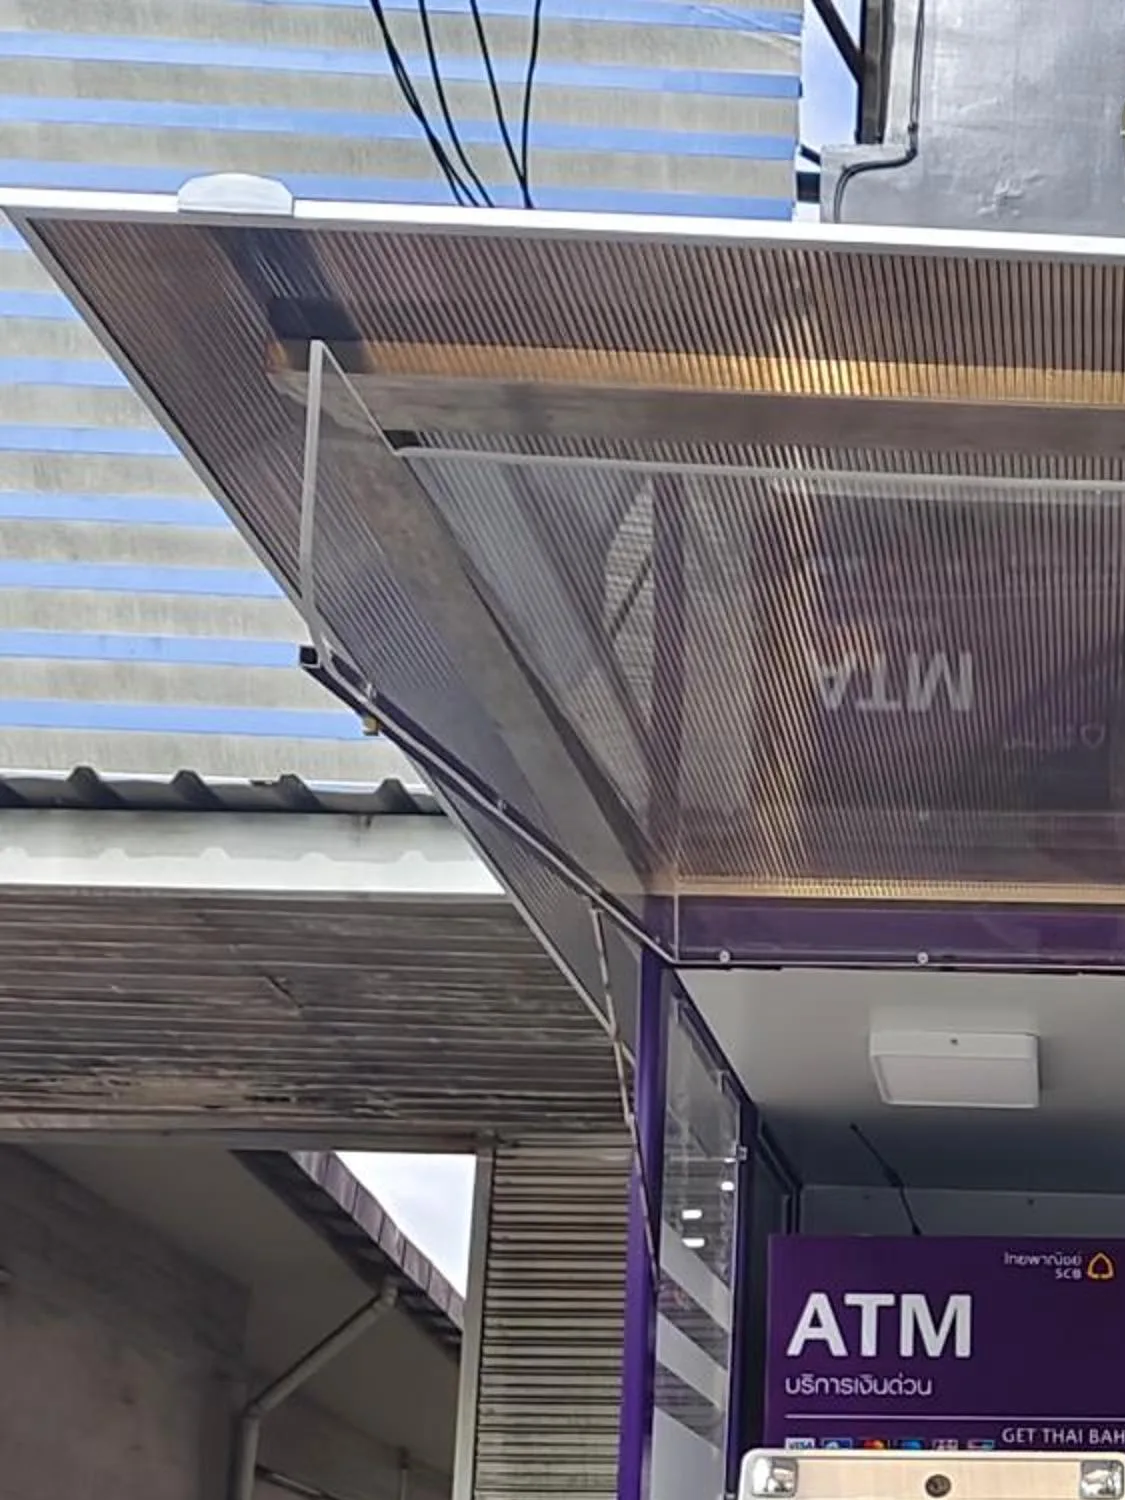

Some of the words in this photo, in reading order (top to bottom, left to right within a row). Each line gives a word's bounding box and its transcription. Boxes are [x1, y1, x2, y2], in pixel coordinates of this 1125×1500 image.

[1055, 1267, 1082, 1280] SCB
[786, 1292, 972, 1358] ATM
[785, 1373, 932, 1397] บริการเงินด่วน
[1002, 1428, 1035, 1444] GET
[1042, 1428, 1083, 1445] THAI
